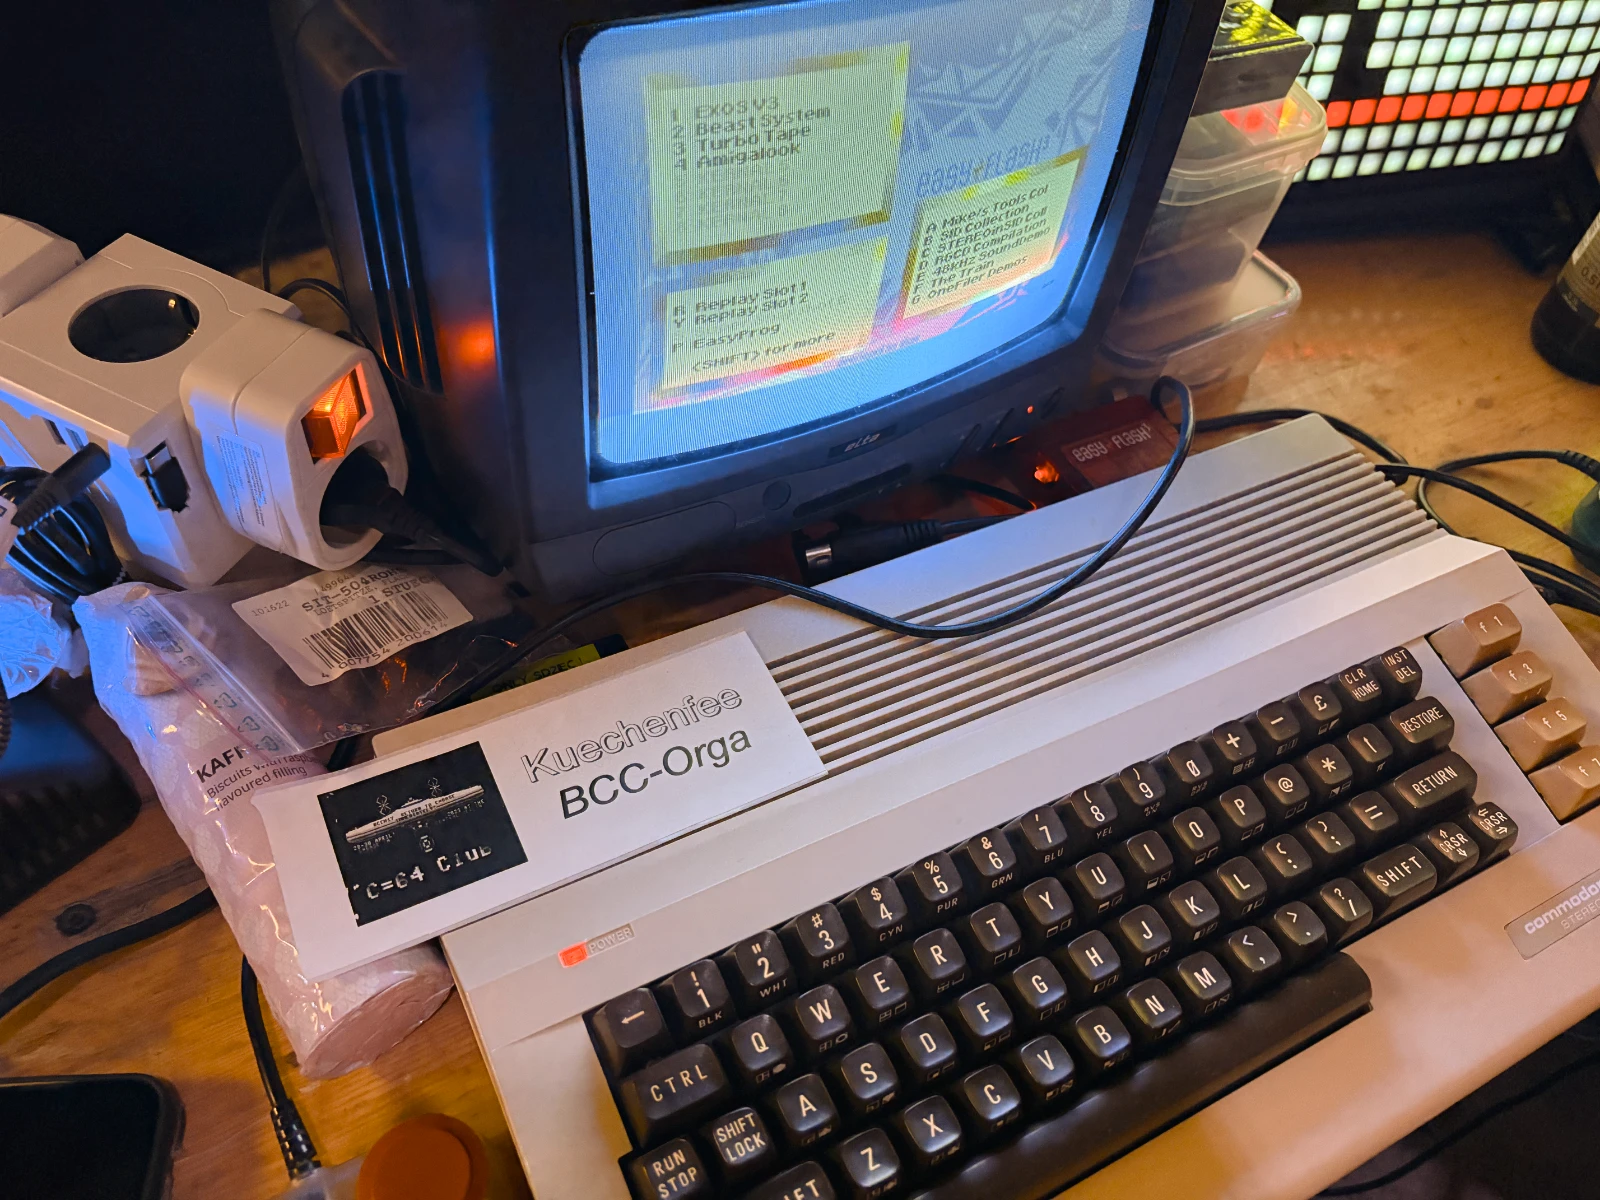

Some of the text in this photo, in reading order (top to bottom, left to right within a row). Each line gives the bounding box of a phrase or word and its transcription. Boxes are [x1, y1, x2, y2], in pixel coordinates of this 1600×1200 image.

[671, 109, 679, 122] 1
[752, 96, 780, 111] V3
[673, 106, 830, 139] 2 Beast System
[674, 124, 811, 156] 3 Turbo Tape
[675, 143, 801, 171] 4 Amigalook
[926, 184, 1049, 234] A Mike's Tools Col
[921, 247, 931, 258] C
[1025, 206, 1047, 222] Coll
[924, 204, 1030, 247] B SID Collection
[919, 260, 928, 271] D
[973, 219, 1047, 252] Compilation
[912, 259, 995, 294] F The Train
[916, 271, 925, 283] E
[986, 255, 1029, 279] Demos
[673, 306, 685, 317] R
[695, 290, 760, 313] Replay
[762, 283, 798, 300] Slot
[673, 292, 809, 329] Y Replay Slot 2
[672, 322, 781, 353] P EasyProg
[763, 341, 790, 357] for
[792, 331, 836, 350] more
[251, 599, 290, 617] 101622
[368, 595, 380, 604] 1
[338, 648, 390, 670] 007754
[397, 622, 448, 647] 200614
[1384, 649, 1408, 667] INST
[1344, 668, 1366, 685] CLR
[1396, 666, 1417, 681] DEL
[1351, 680, 1379, 699] HOME
[1313, 695, 1327, 711] £
[1400, 706, 1443, 734] RESTORE
[520, 688, 743, 784] Kuechenfee
[1226, 732, 1240, 748] +
[206, 764, 253, 799] Biscuits
[273, 764, 308, 780] filling
[559, 729, 752, 819] BCC-Orga
[1411, 765, 1458, 796] RETURN
[1138, 782, 1154, 799] 9
[1277, 777, 1294, 793] @
[1089, 805, 1105, 822] 8
[1234, 798, 1245, 816] P
[1188, 821, 1204, 838] O
[1480, 811, 1508, 832] CRSR
[980, 836, 993, 850] &
[1039, 825, 1053, 844] 7
[1095, 826, 1113, 840] YEL
[1439, 832, 1469, 853] CRSR
[988, 851, 1004, 870] 6
[1044, 848, 1064, 864] BLU
[1143, 844, 1155, 861] I
[924, 859, 940, 875] %
[1090, 866, 1107, 885] U
[1376, 855, 1422, 888] SHIFT
[932, 875, 949, 894] 5
[991, 872, 1013, 890] GRN
[1232, 873, 1250, 891] L
[870, 886, 882, 901] $
[1038, 891, 1054, 910] Y
[879, 903, 893, 921] 4
[937, 897, 958, 914] PUR
[1184, 896, 1203, 915] K
[811, 912, 823, 928] #
[985, 917, 1001, 937] T
[1141, 920, 1153, 940] J
[588, 927, 633, 954] POWER
[818, 930, 835, 950] 3
[878, 924, 904, 942] CYN
[822, 952, 845, 969] RED
[929, 945, 948, 966] R
[1085, 946, 1104, 967] H
[757, 957, 775, 979] 2
[1193, 967, 1217, 989] M
[690, 971, 699, 987] !
[759, 979, 788, 998] WHT
[872, 971, 890, 993] E
[1031, 974, 1049, 994] G
[696, 988, 711, 1009] 1
[1144, 995, 1165, 1016] N
[698, 1011, 724, 1029] BLK
[809, 998, 832, 1024] W
[976, 1001, 991, 1023] F
[751, 1031, 769, 1053] Q
[919, 1032, 937, 1053] D
[1093, 1024, 1112, 1044] B
[1036, 1049, 1055, 1071] V
[650, 1064, 708, 1102] CTRL
[860, 1062, 878, 1084] S
[799, 1093, 817, 1117] A
[983, 1084, 1002, 1105] C
[716, 1112, 755, 1144] SHIFT
[922, 1113, 944, 1138] X
[725, 1132, 766, 1162] LOCK
[652, 1149, 686, 1177] RUN
[860, 1147, 881, 1171] Z
[658, 1166, 698, 1199] STOP
